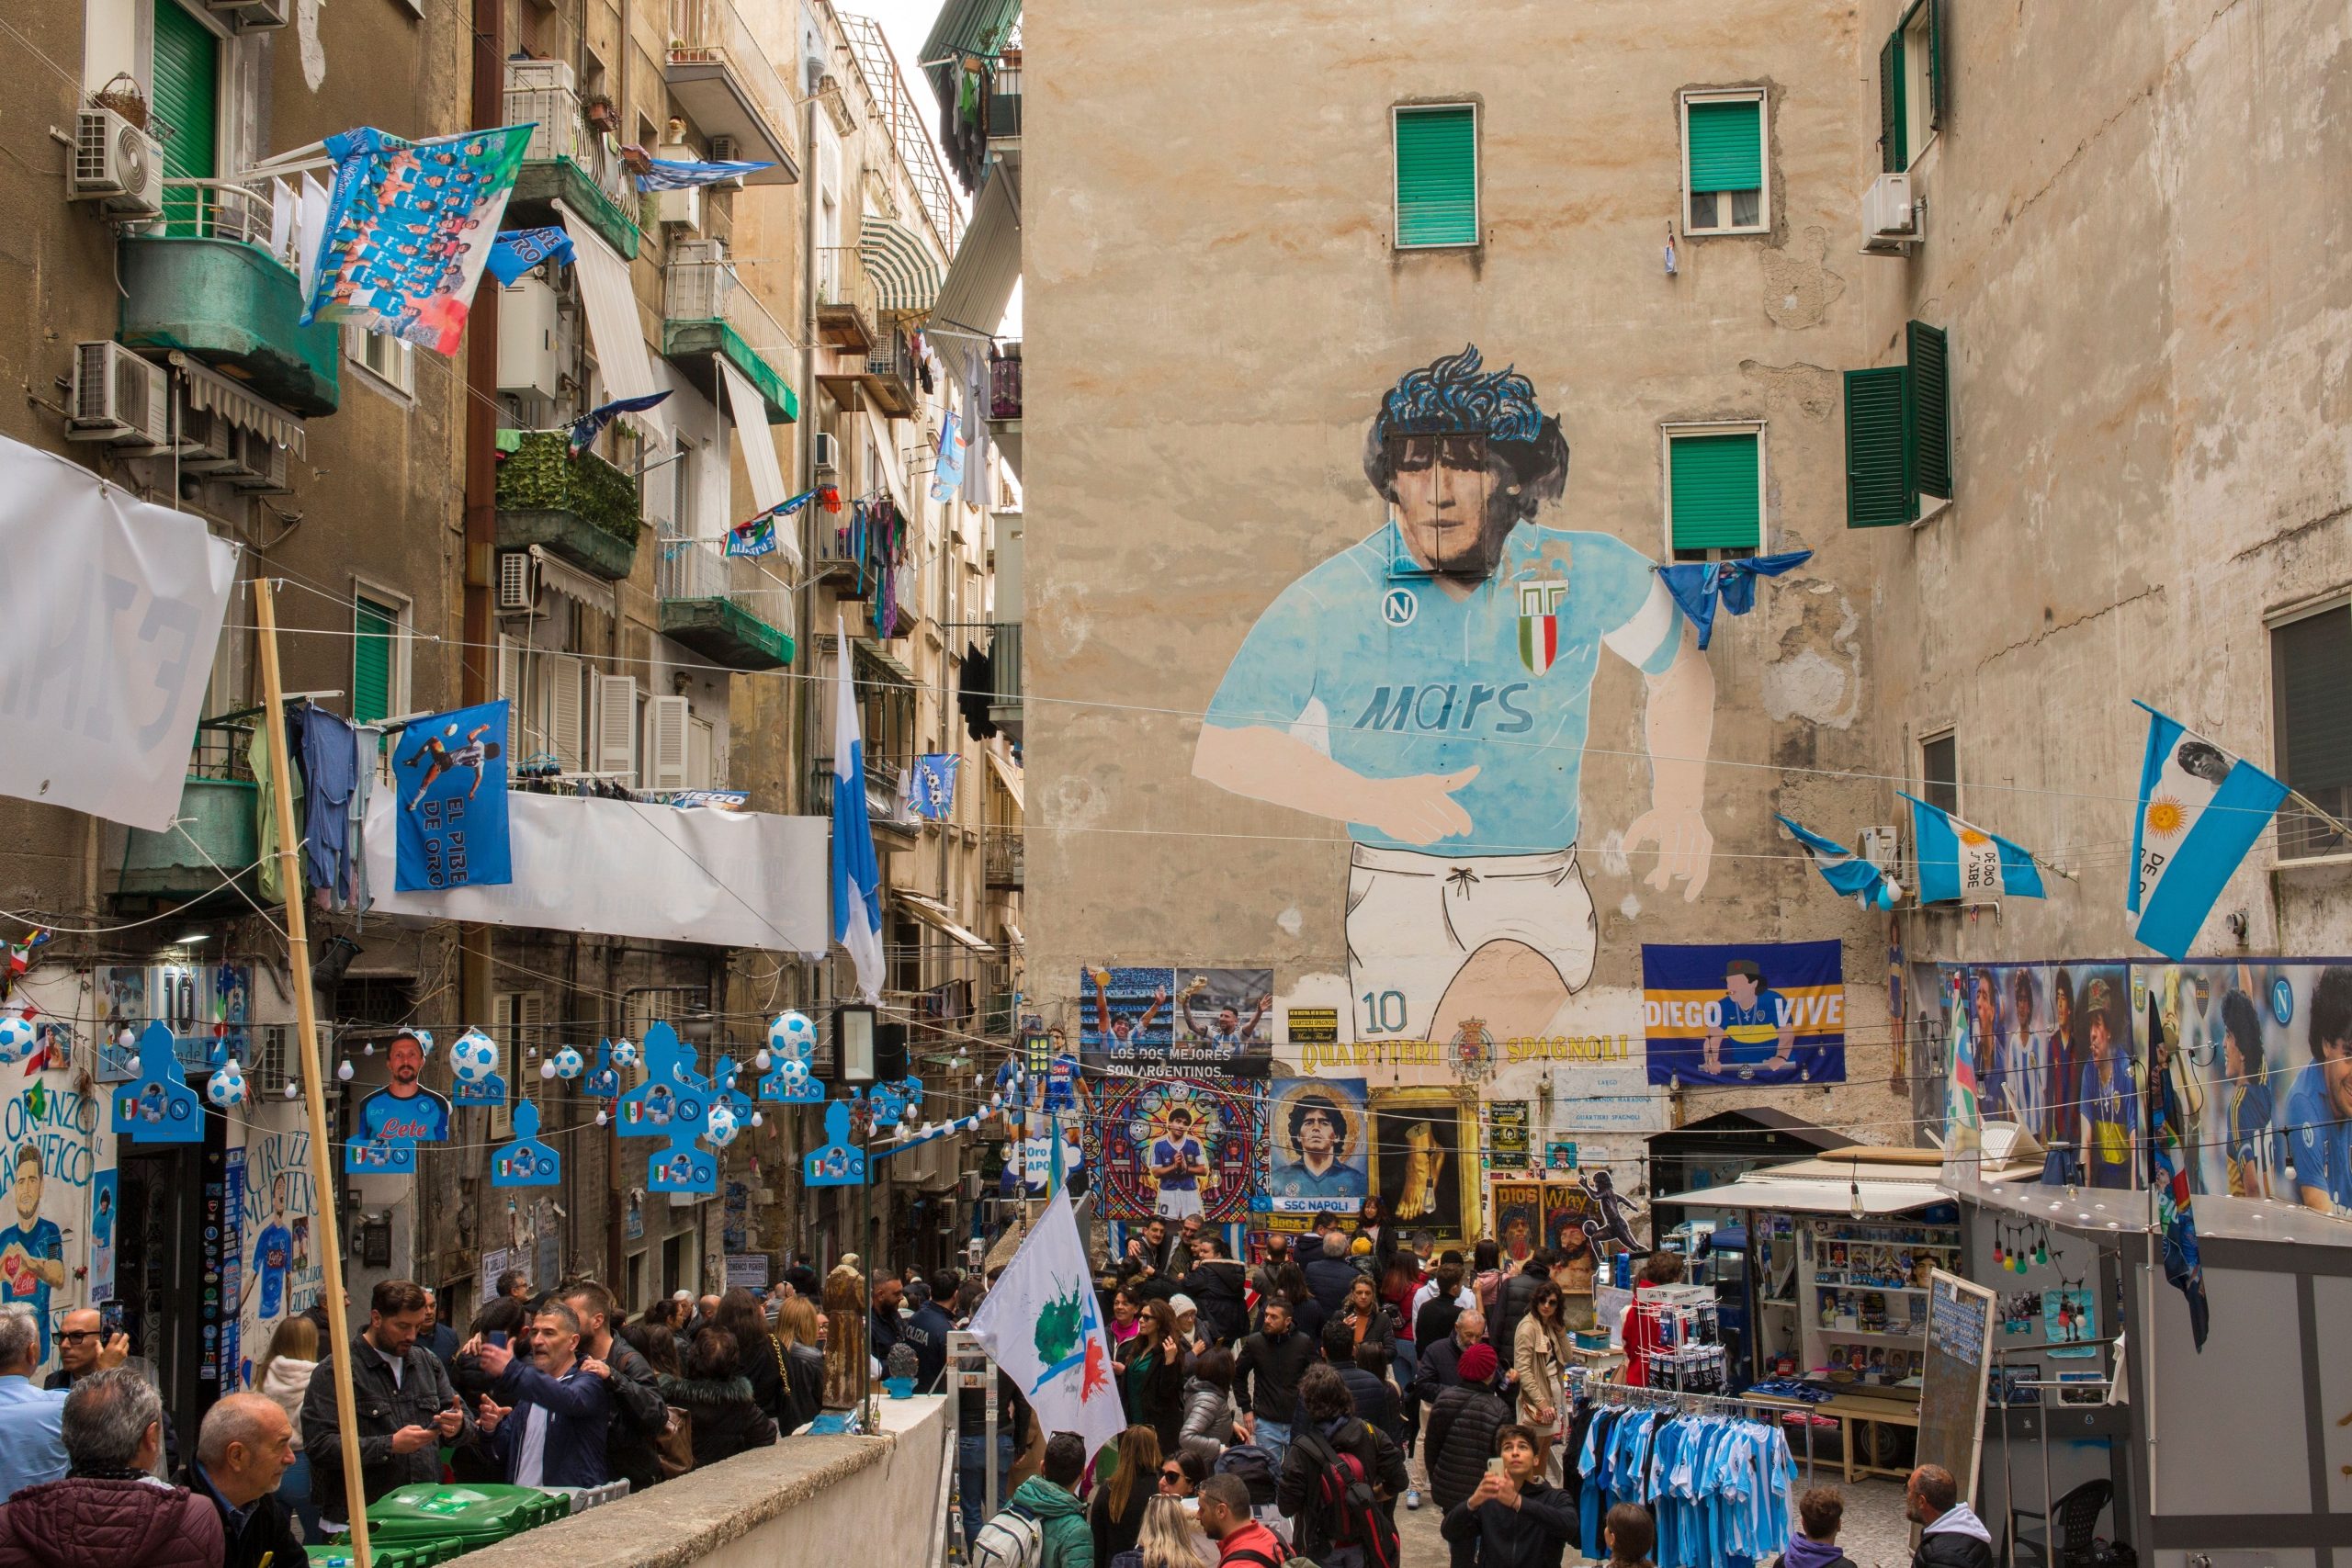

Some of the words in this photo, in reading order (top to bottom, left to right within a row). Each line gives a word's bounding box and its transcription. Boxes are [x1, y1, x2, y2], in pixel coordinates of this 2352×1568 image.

[1353, 682, 1533, 733] Mars
[423, 800, 441, 831] DE
[447, 796, 465, 824] EL
[424, 838, 445, 887] ORO
[447, 830, 469, 885] PIBE
[164, 973, 195, 1034] 10
[1361, 989, 1408, 1034] 10
[1645, 1000, 1723, 1027] DIEGO
[1774, 995, 1844, 1027] VIVE
[1110, 1048, 1136, 1059] LOS
[1138, 1048, 1164, 1060] DOS
[1169, 1048, 1231, 1061] MEJORES
[1301, 1041, 1441, 1075] QUARTIERI
[1506, 1034, 1629, 1065] SPAGNOLI
[1106, 1065, 1134, 1076] SON
[378, 1118, 427, 1139] Lete
[1284, 1201, 1306, 1211] SSC
[1308, 1201, 1349, 1211] NAPOLI
[1498, 1188, 1538, 1203] DIOS
[1544, 1188, 1588, 1213] Why
[13, 1275, 36, 1292] Lete
